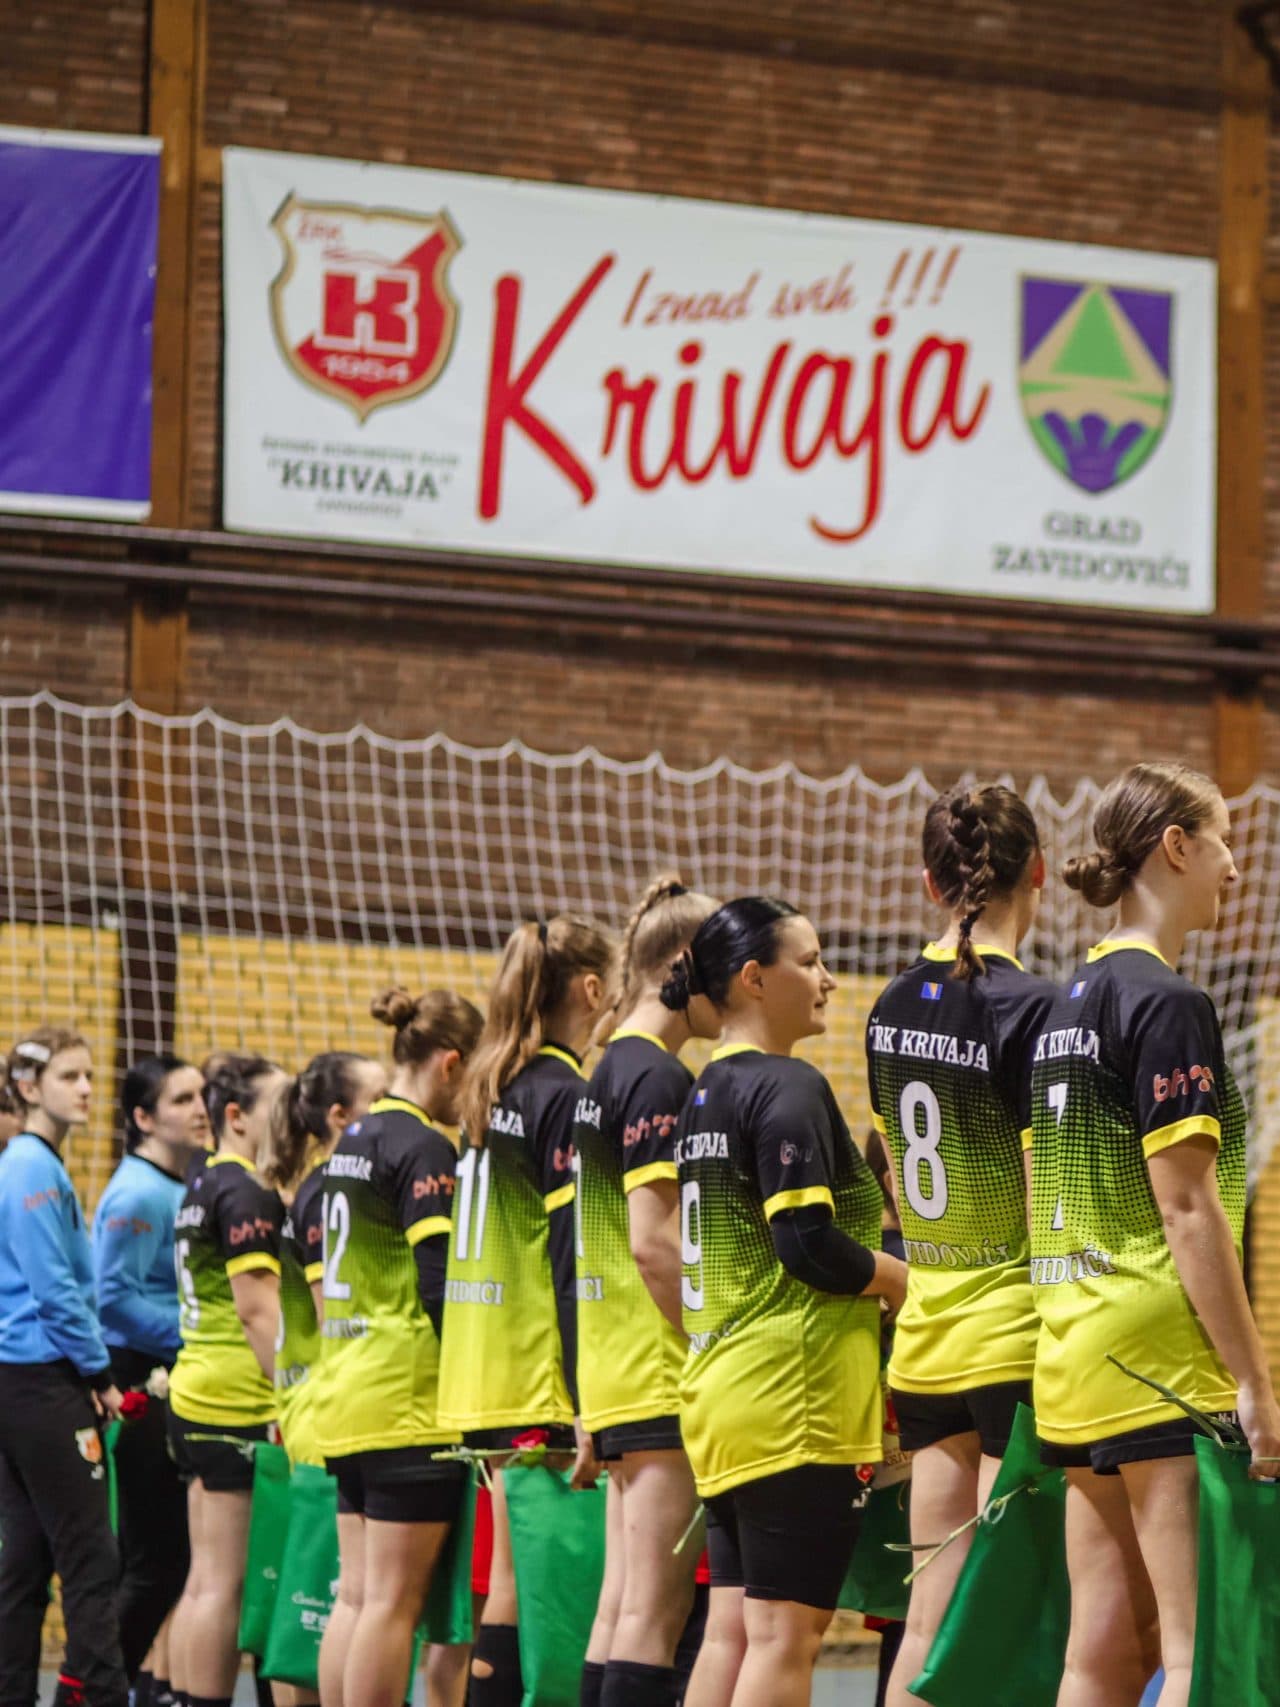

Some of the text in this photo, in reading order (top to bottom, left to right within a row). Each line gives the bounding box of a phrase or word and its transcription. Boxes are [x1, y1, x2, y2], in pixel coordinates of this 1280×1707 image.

[478, 250, 991, 546] Krivaja
[1043, 511, 1142, 545] GRAD
[900, 1029, 990, 1072] KRIVAJA
[455, 1147, 491, 1261] 11
[899, 1080, 949, 1221] 8
